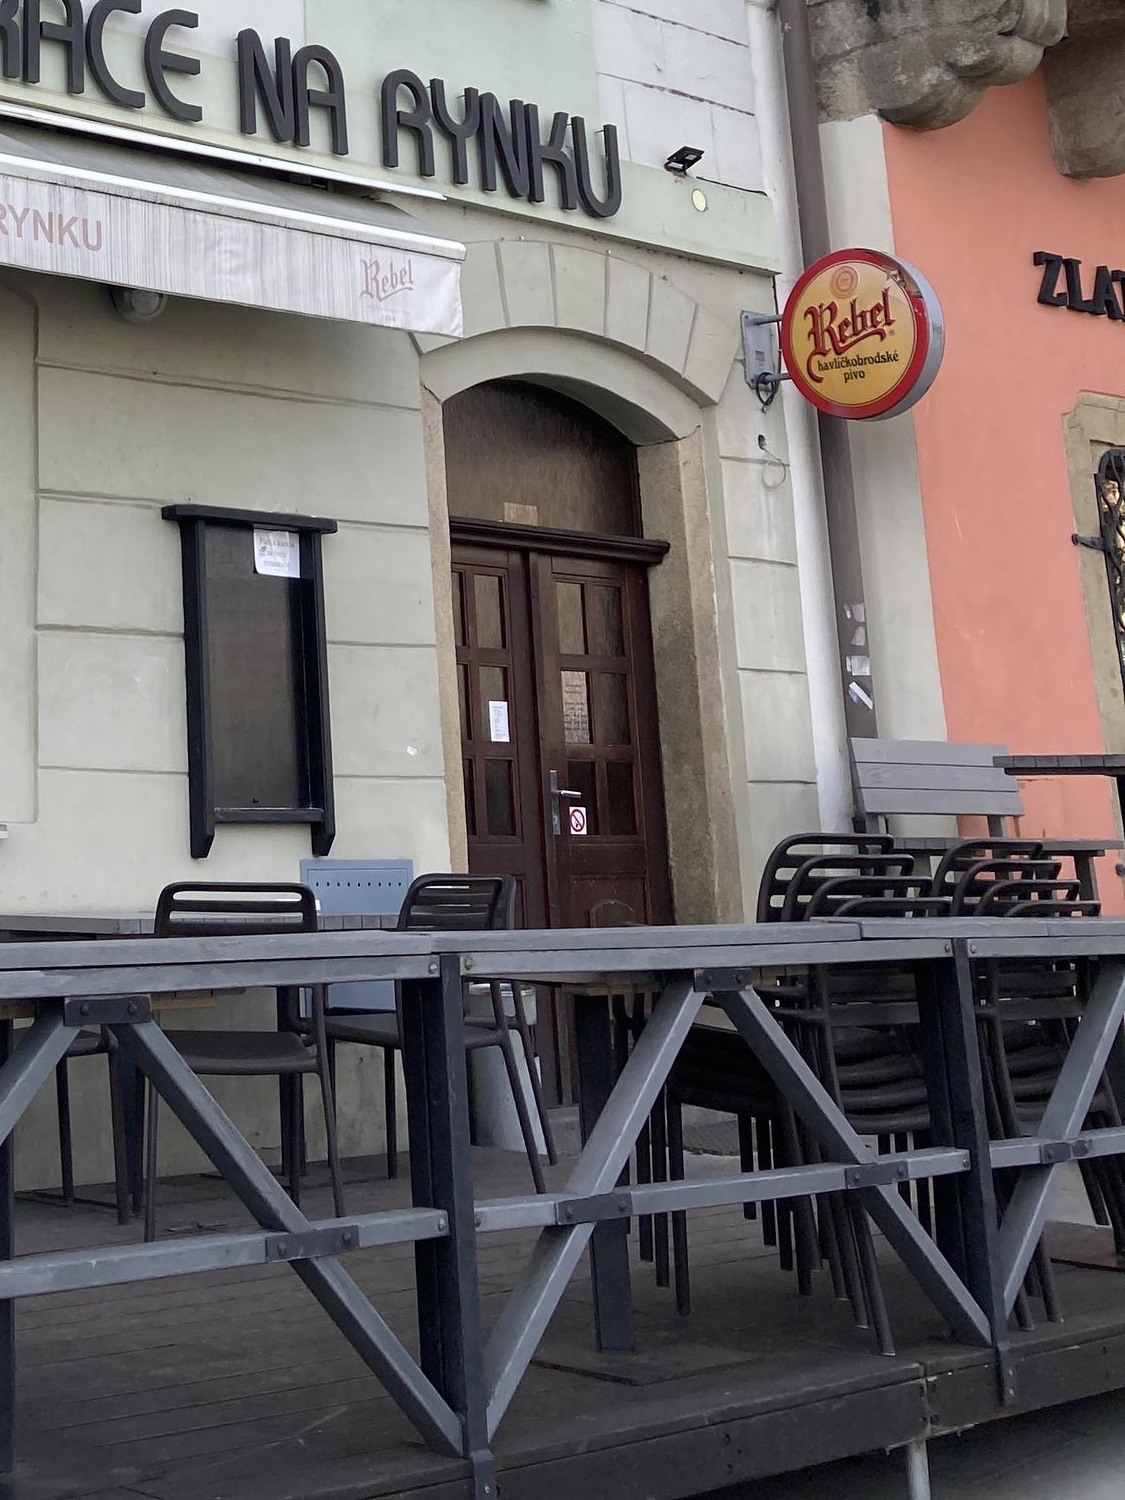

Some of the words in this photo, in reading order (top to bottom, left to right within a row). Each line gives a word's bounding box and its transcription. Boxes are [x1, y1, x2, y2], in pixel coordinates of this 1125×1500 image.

[236, 27, 349, 156] NA
[381, 68, 622, 219] RYNKU
[360, 259, 414, 302] Rebel
[804, 286, 896, 383] Rebel
[818, 349, 900, 372] havlíčkobrodské
[843, 368, 865, 383] pivo
